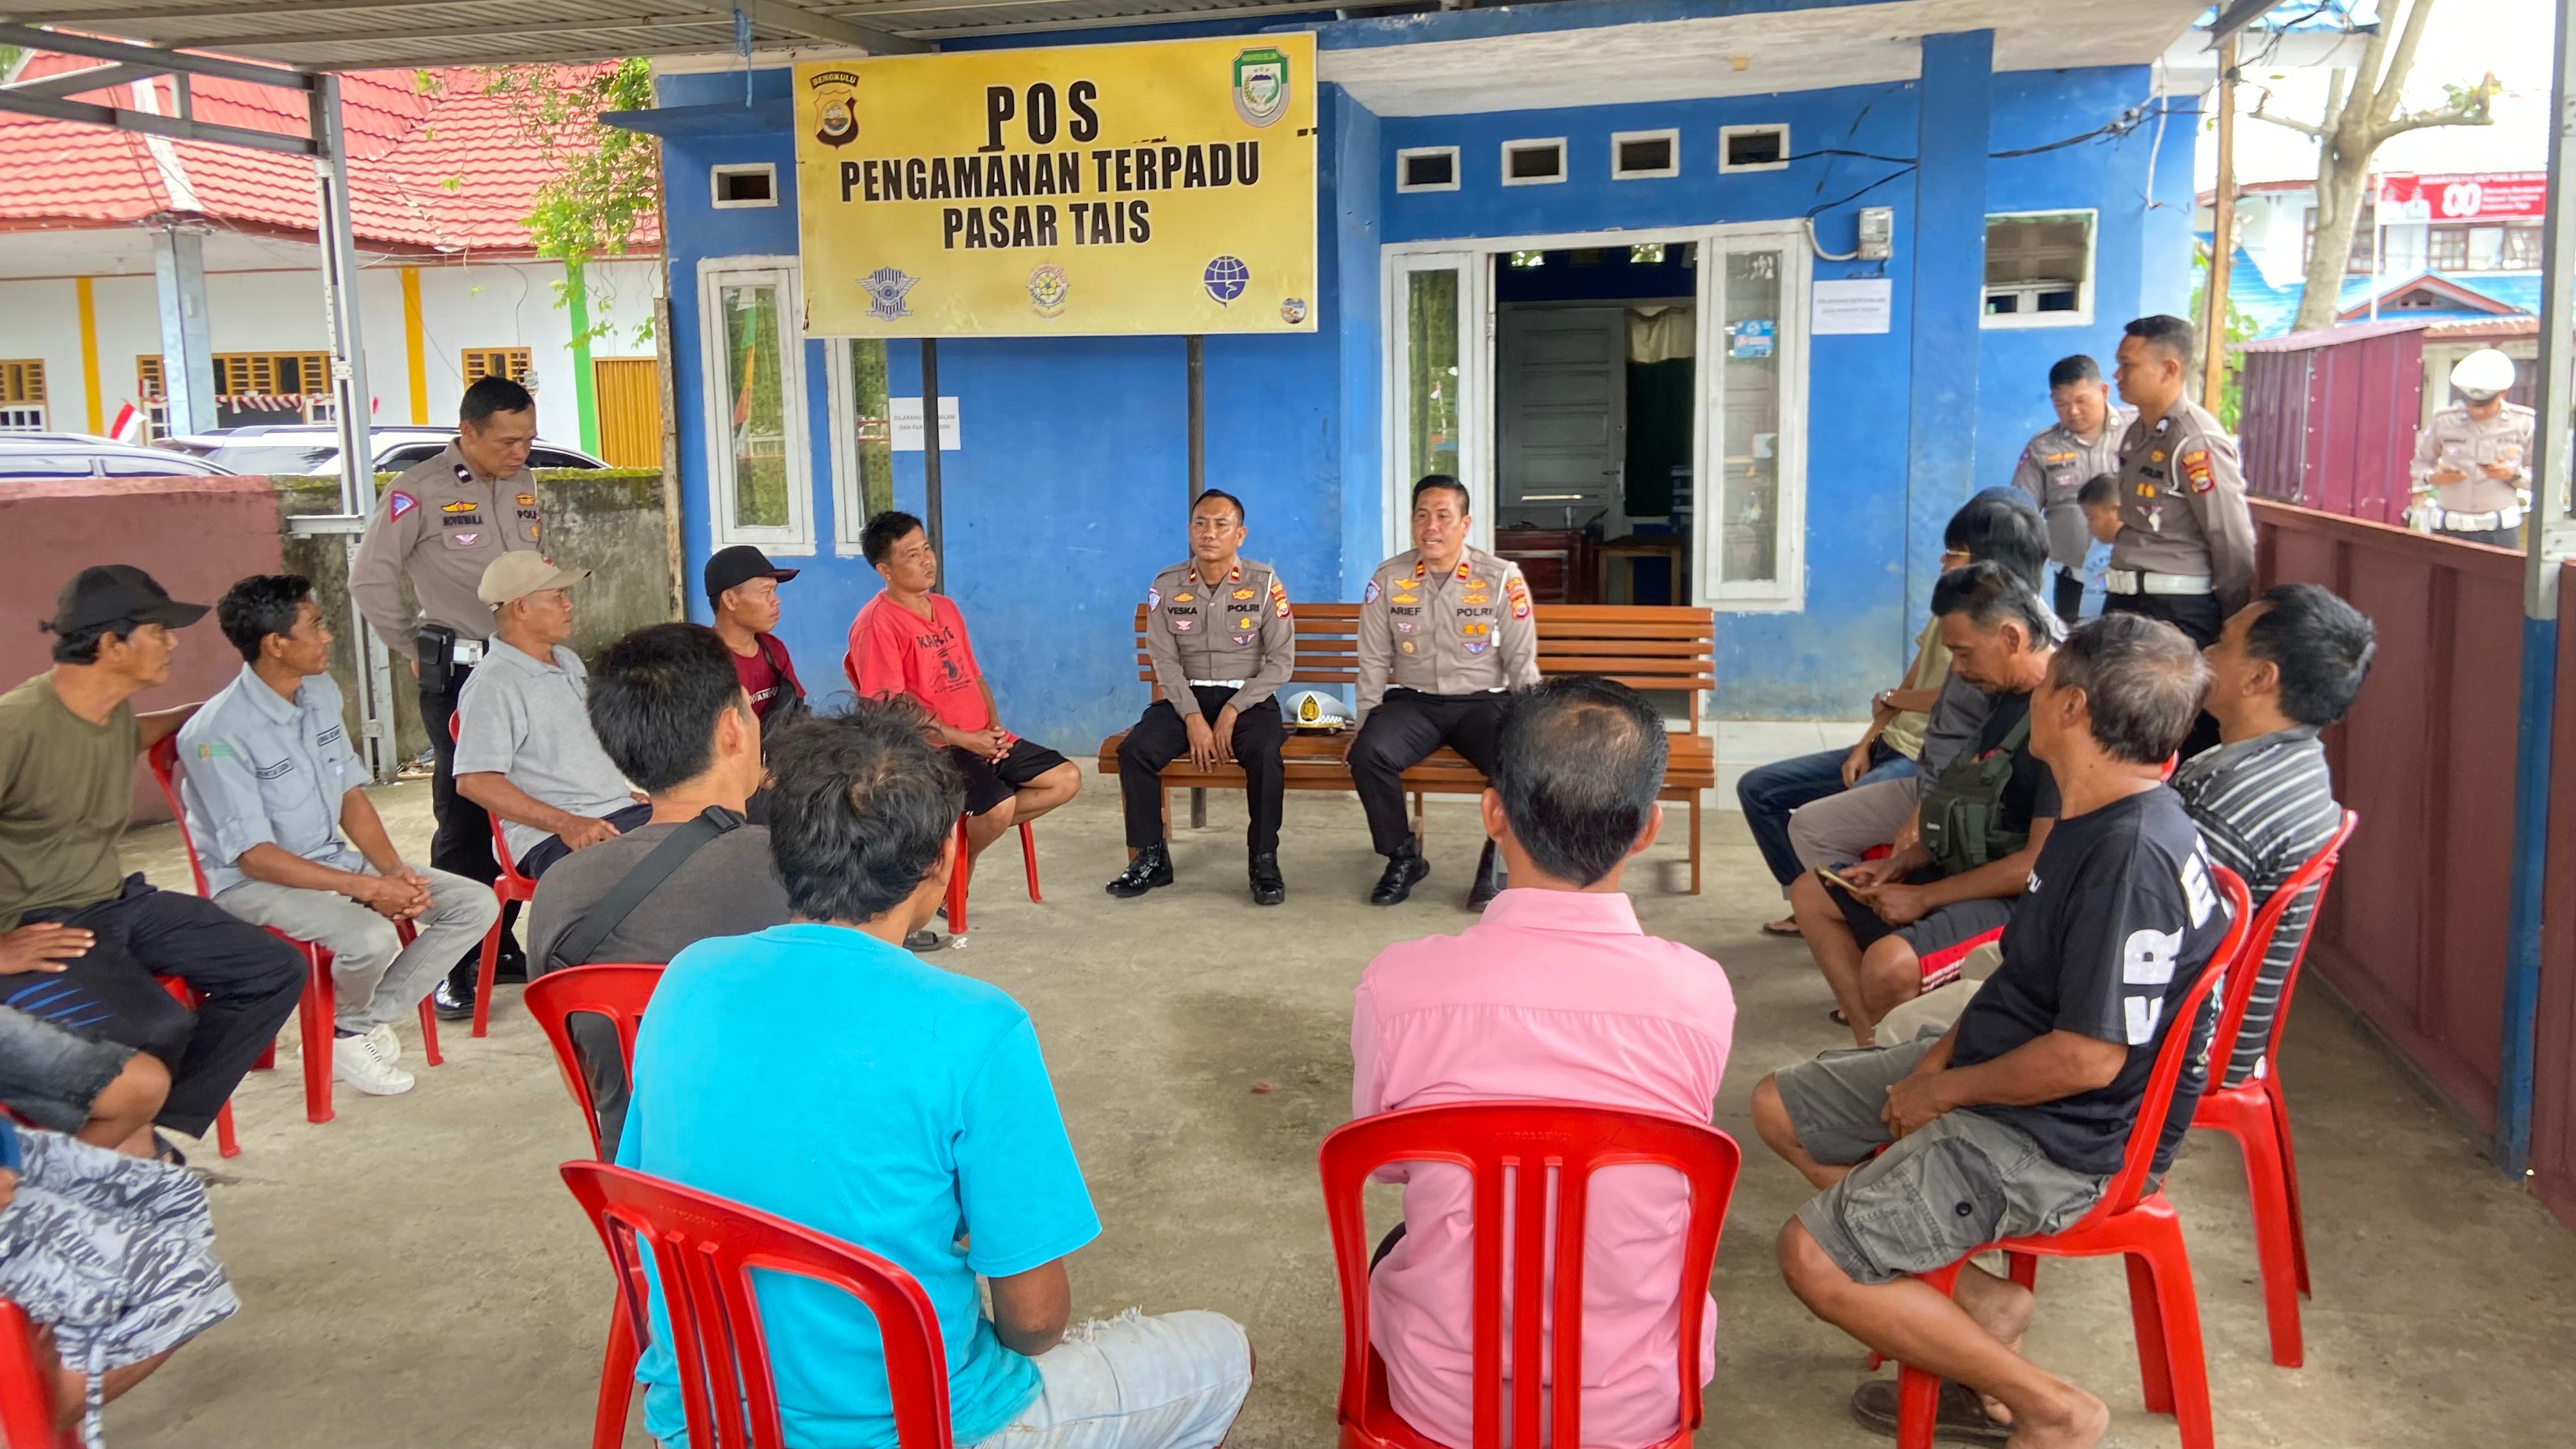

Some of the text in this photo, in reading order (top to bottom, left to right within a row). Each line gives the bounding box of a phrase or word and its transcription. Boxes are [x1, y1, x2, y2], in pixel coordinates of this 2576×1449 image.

[813, 73, 856, 86] BENGKULU
[985, 80, 1098, 148] POS
[841, 142, 1259, 201] PENGAMANAN TERPADU
[944, 201, 1151, 249] PASAR TAIS
[1167, 606, 1198, 615] VESKA
[1227, 604, 1261, 612] POLRI
[1390, 606, 1422, 616] ARIEF
[1456, 607, 1493, 617] POLRI
